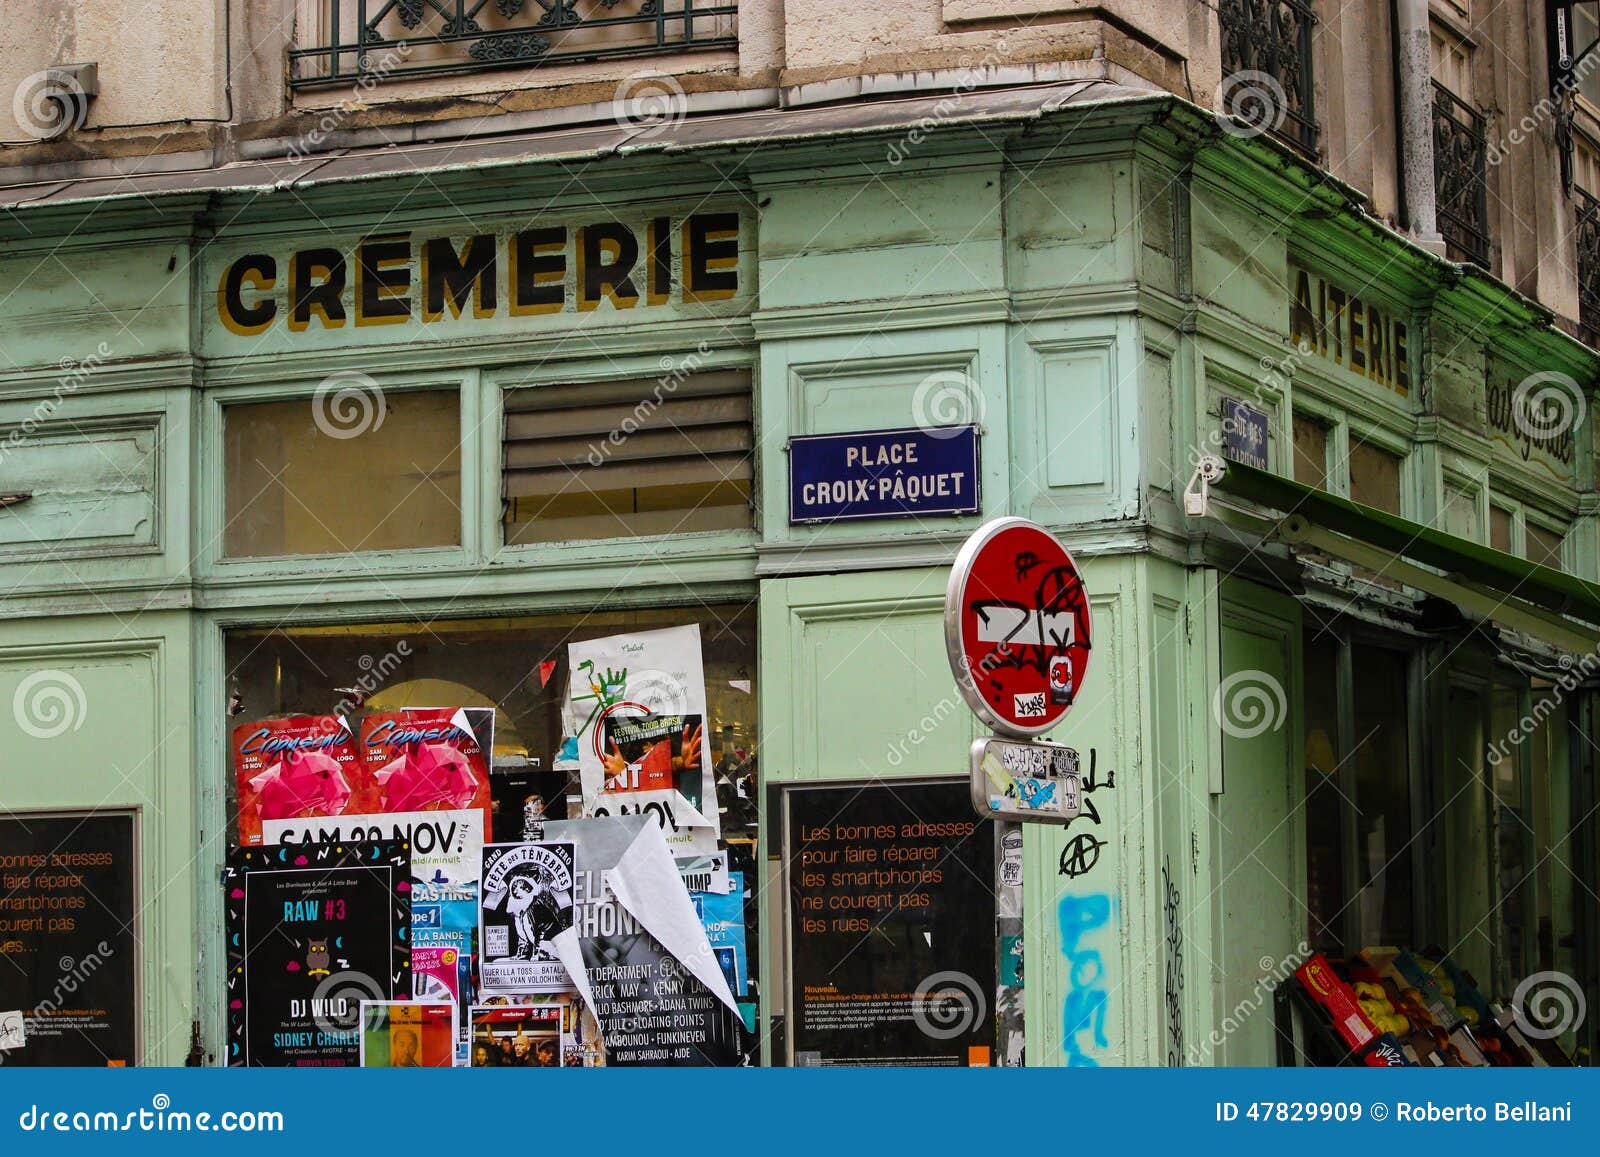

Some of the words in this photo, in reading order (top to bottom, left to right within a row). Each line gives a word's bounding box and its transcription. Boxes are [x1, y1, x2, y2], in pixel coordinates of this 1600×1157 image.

[1289, 270, 1409, 399] AITERIE
[846, 442, 919, 468] PLACE
[802, 469, 965, 505] CROIX-PÂQUET
[613, 724, 641, 738] FESTIVAL
[463, 747, 480, 755] LOGO
[802, 824, 831, 841] Les
[836, 823, 896, 841] bonnes
[901, 820, 975, 838] adresses
[51, 850, 113, 867] adresses
[555, 845, 573, 866] ZERO
[802, 850, 839, 868] pour
[845, 845, 878, 864] faire
[882, 844, 939, 865] réparer
[3, 872, 31, 889] faire
[35, 871, 84, 891] réparer
[802, 870, 825, 888] les
[831, 867, 944, 888] smartphones
[0, 893, 86, 912] martphones
[284, 900, 319, 922] RAW
[324, 899, 347, 921] #3
[802, 895, 824, 911] ne
[829, 891, 893, 910] courent
[899, 892, 930, 912] pas
[0, 915, 44, 932] ourent
[48, 917, 76, 934] pas
[802, 916, 826, 933] les
[419, 932, 430, 941] LA
[433, 931, 464, 940] BANDE
[484, 968, 515, 977] GUERILLA
[517, 967, 532, 976] TOSS
[510, 976, 526, 984] YVAN
[528, 974, 563, 984] VOLOCHINE
[596, 963, 653, 981] DEPARTMENT
[620, 983, 640, 998] MAY
[653, 981, 685, 997] KENNY
[804, 985, 839, 993] Nouveau.
[851, 993, 872, 1002] Orange
[291, 1000, 306, 1018] DJ
[311, 998, 347, 1018] W!LD
[612, 1001, 654, 1014] BASHMORE
[659, 998, 687, 1012] ADANA
[688, 996, 714, 1010] TWINS
[633, 1015, 671, 1029] FLOATING
[674, 1013, 705, 1027] POINTS
[273, 1032, 313, 1048] SIDNEY
[316, 1030, 360, 1047] CHARLE
[604, 1033, 650, 1048] AMBOUNOU
[656, 1030, 706, 1045] FUNKINEVEN
[616, 1049, 637, 1063] KARIM
[637, 1048, 669, 1061] SAHRAOUI
[674, 1047, 691, 1059] AJDE
